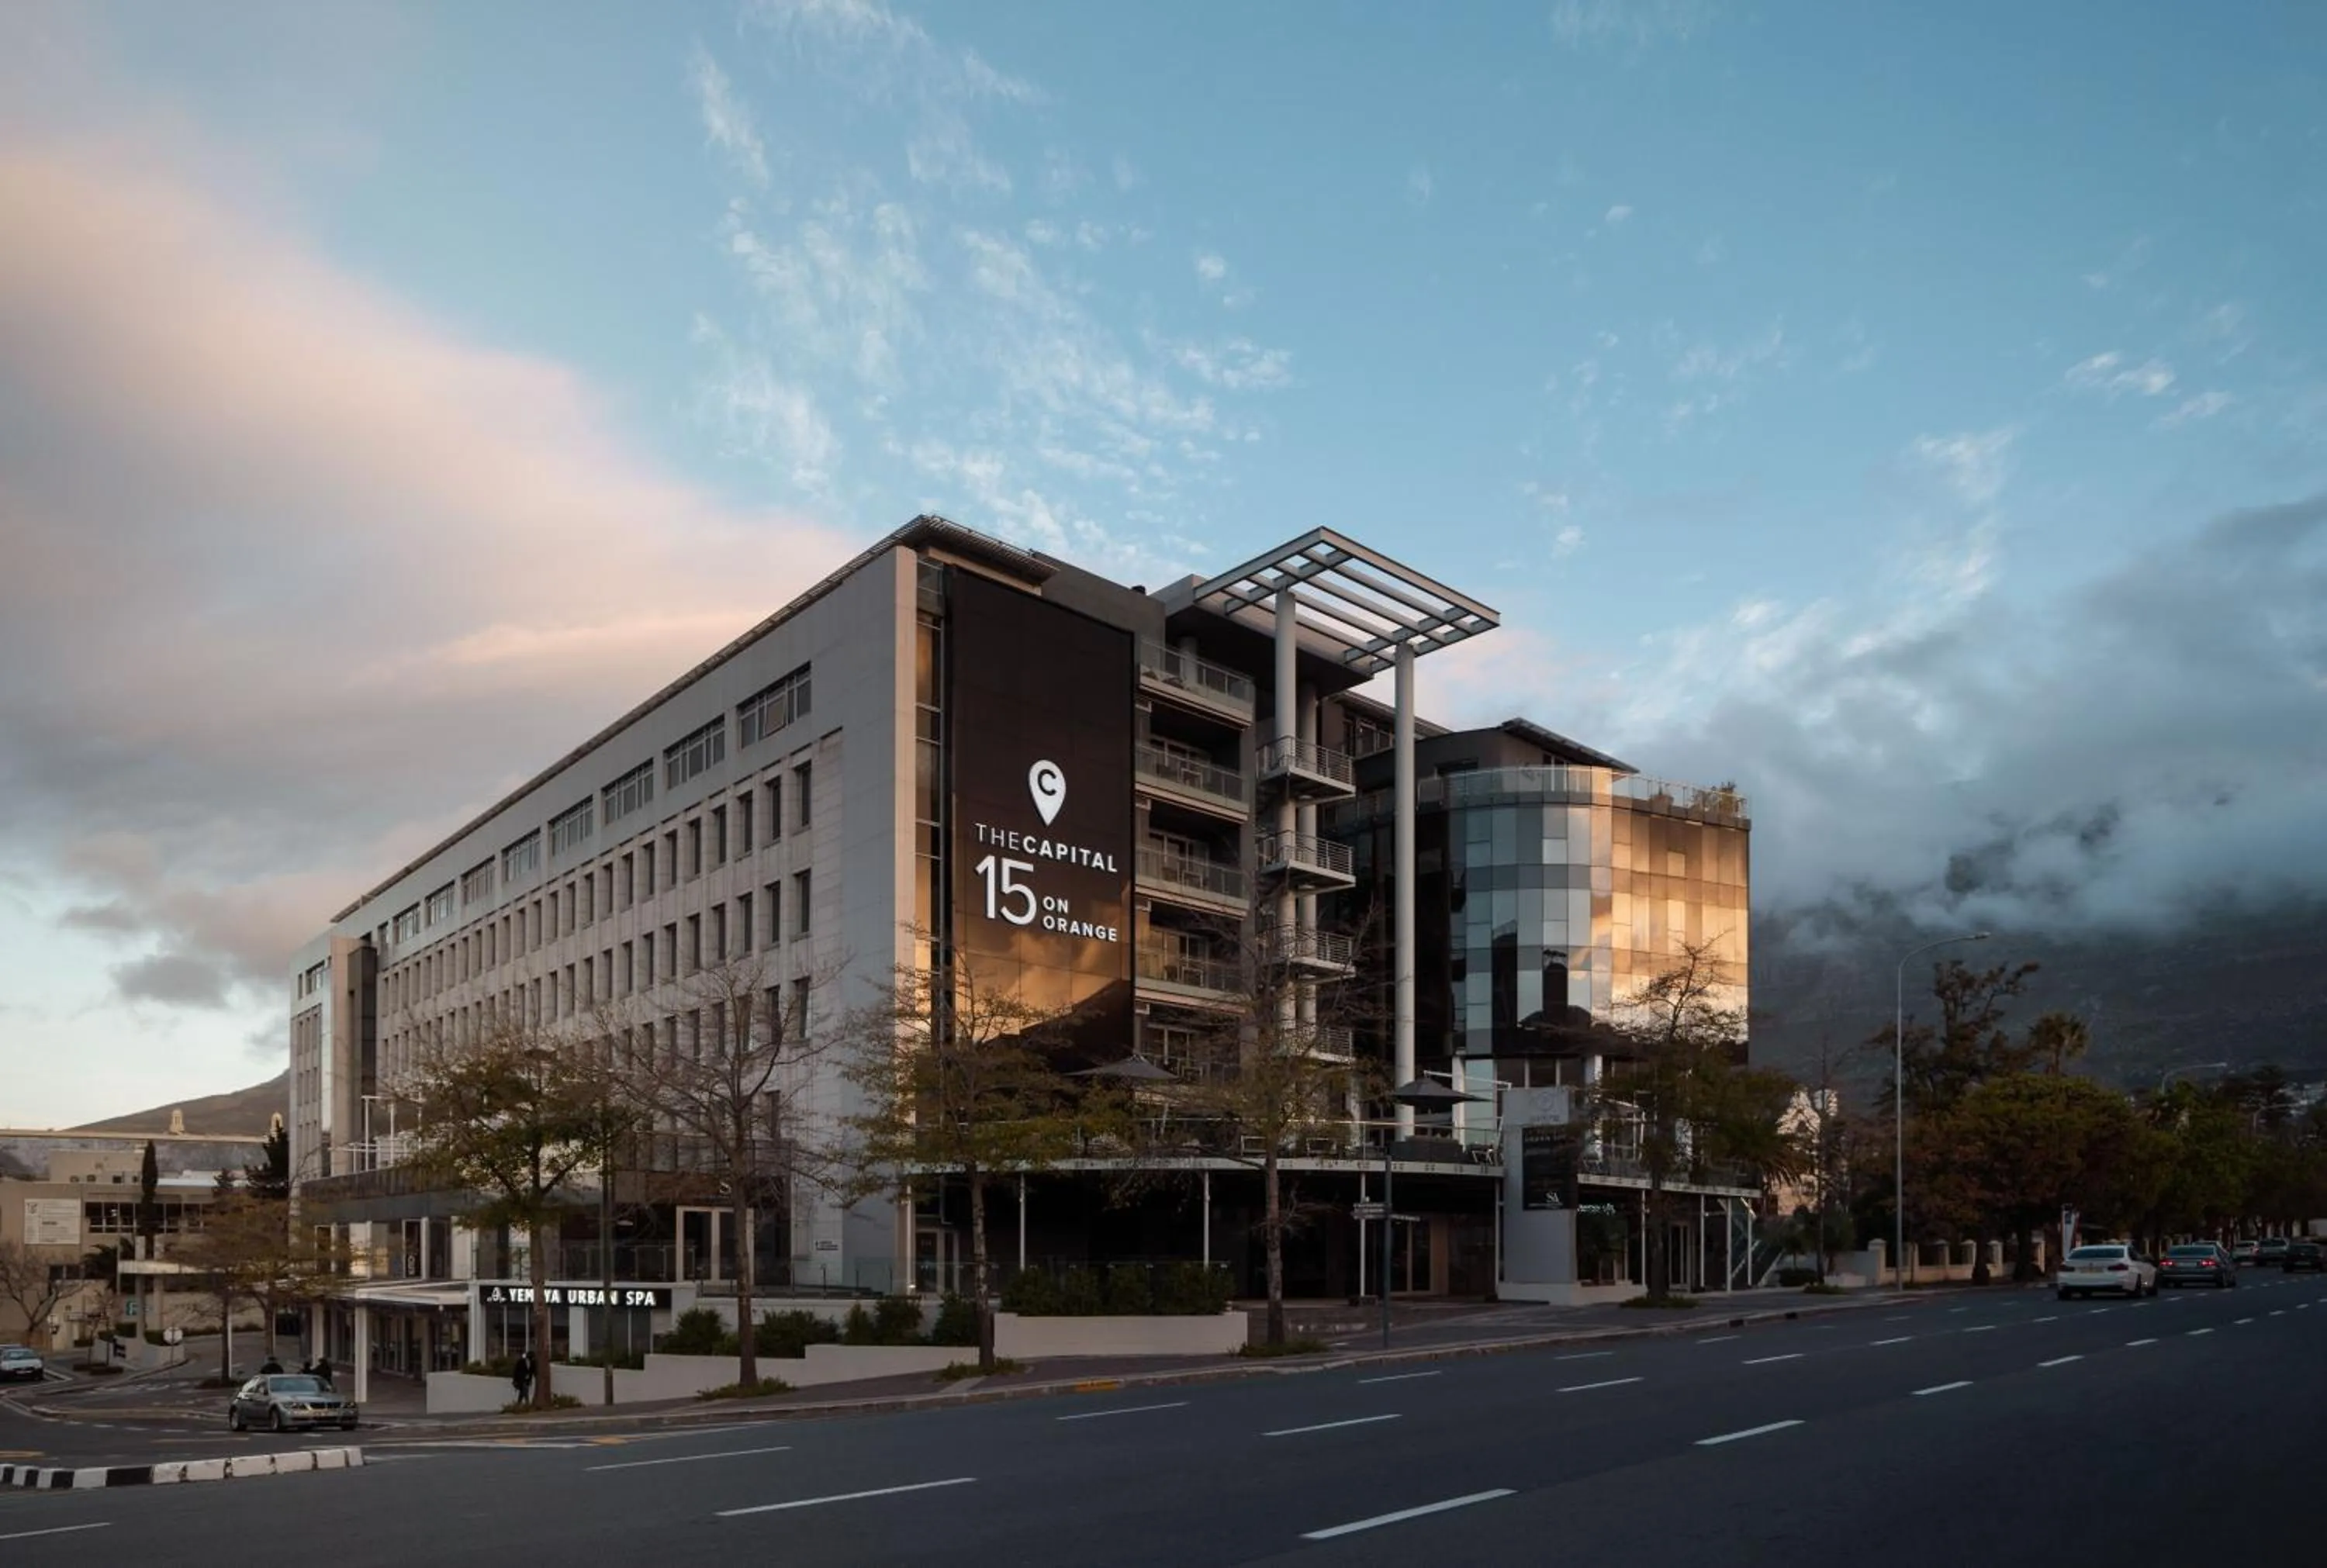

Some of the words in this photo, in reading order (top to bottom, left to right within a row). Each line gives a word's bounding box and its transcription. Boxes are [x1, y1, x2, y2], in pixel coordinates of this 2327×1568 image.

[1038, 768, 1056, 796] C
[975, 855, 1037, 925] 15
[1042, 896, 1068, 914] ON
[1042, 915, 1118, 942] ORANGE
[509, 1288, 562, 1304] YEMYA
[626, 1290, 656, 1307] SPA
